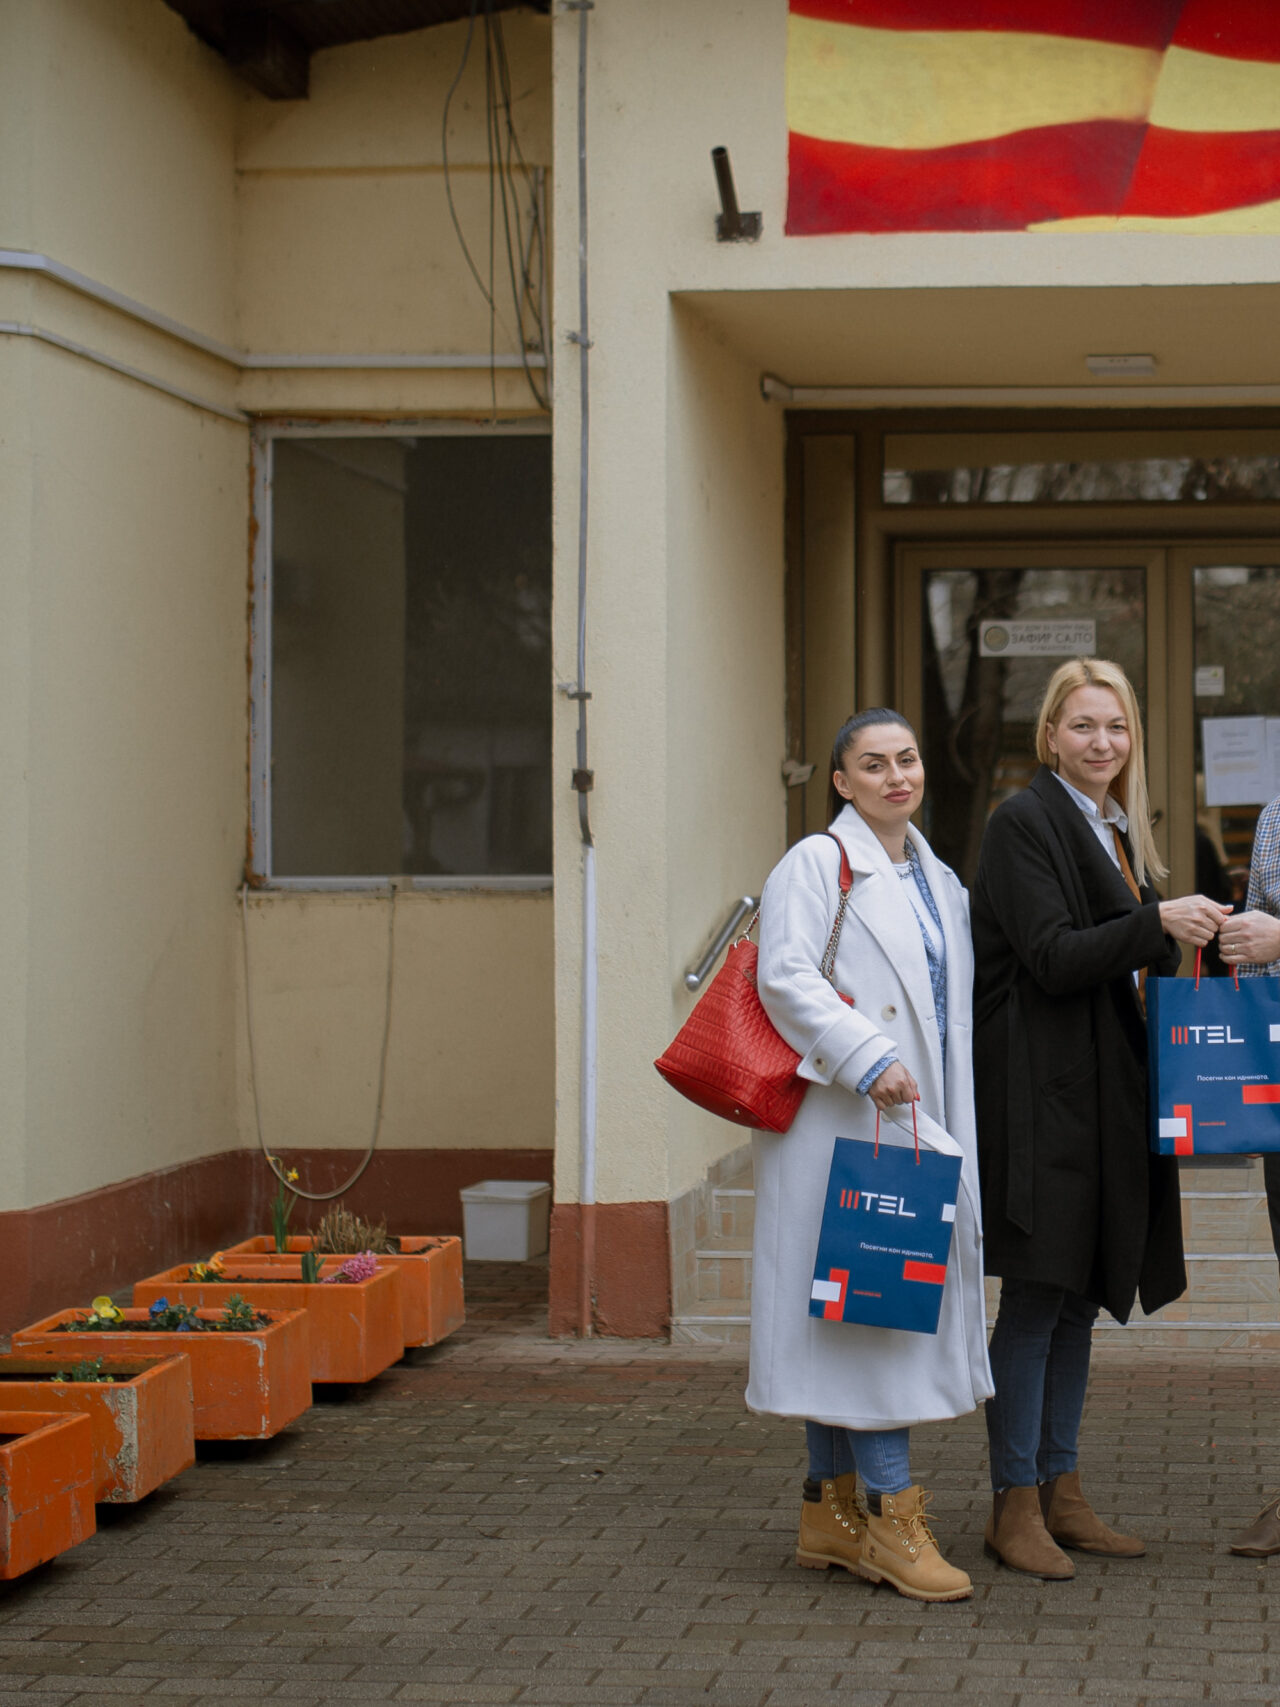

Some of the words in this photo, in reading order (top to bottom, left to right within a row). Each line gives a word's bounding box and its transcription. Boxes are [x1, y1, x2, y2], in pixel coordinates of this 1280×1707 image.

[1011, 633, 1052, 644] ЗАФИР
[1196, 1074, 1224, 1082] Посегни
[860, 1241, 888, 1253] Посегни
